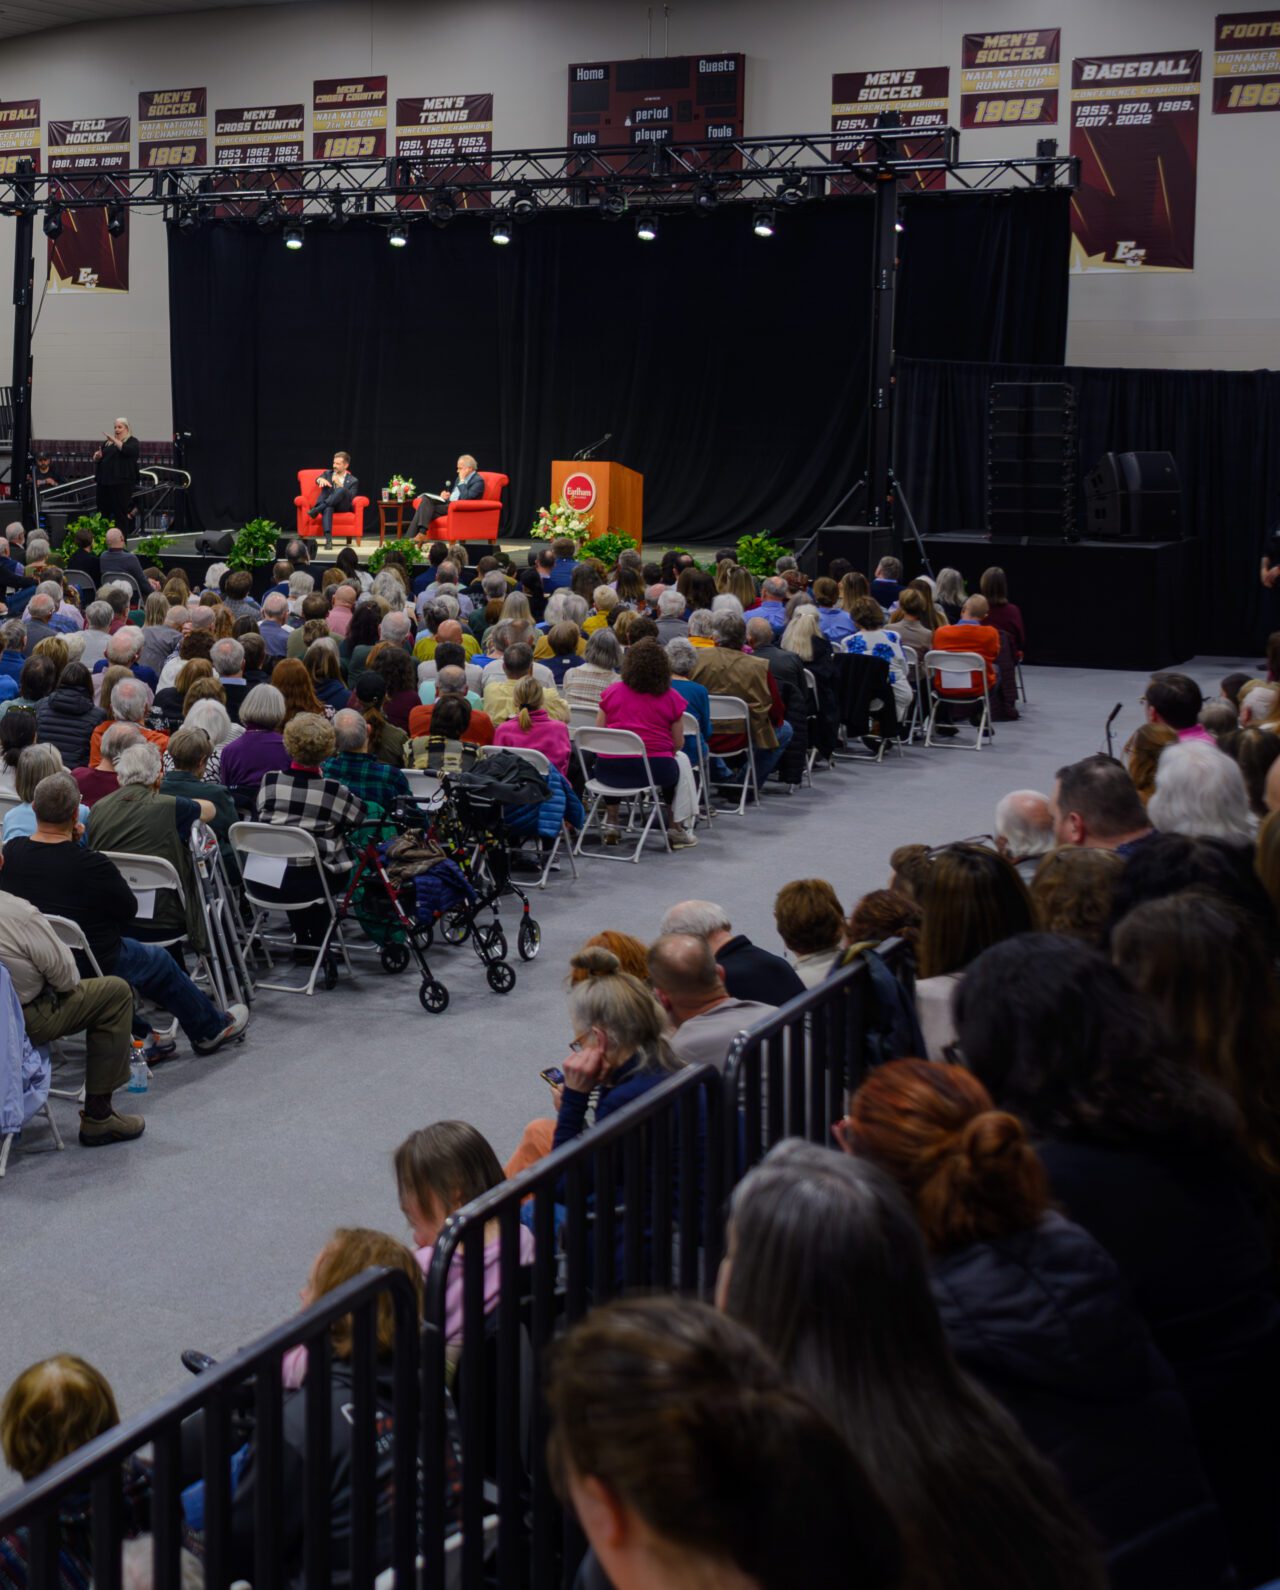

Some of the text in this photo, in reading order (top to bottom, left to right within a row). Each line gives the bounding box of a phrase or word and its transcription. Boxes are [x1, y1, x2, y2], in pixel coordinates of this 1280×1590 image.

[983, 32, 1039, 49] MEN'S
[975, 46, 1046, 64] SOCCER
[699, 60, 734, 73] Guests
[1082, 59, 1191, 80] BASEBALL
[576, 68, 604, 80] Home
[864, 70, 916, 86] MEN'S
[966, 68, 1055, 80] NAIA NATIONAL
[152, 90, 192, 104] MEN'S
[858, 85, 922, 101] SOCCER
[1073, 85, 1198, 98] CONFERENCE CHAMPIONS
[1228, 83, 1280, 108] 196
[148, 102, 198, 116] SOCCER
[422, 96, 466, 110] MEN'S
[834, 100, 944, 113] CONFERENCE CHAMPIONS
[243, 109, 276, 120] MEN'S
[316, 110, 384, 120] NAIA NATIONAL
[419, 110, 468, 124] TENNIS
[636, 107, 668, 122] period
[974, 98, 1044, 123] 1965
[72, 120, 106, 132] FIELD
[164, 120, 202, 129] NATIONAL
[216, 118, 303, 133] CROSS COUNTRY
[344, 119, 374, 128] PLACE
[1116, 114, 1152, 126] 2022
[65, 131, 112, 144] HOCKEY
[573, 132, 596, 145] fouls
[635, 129, 668, 144] player
[708, 126, 732, 138] fouls
[324, 136, 376, 158] 1963
[101, 157, 122, 166] 1984
[148, 146, 196, 166] 1963
